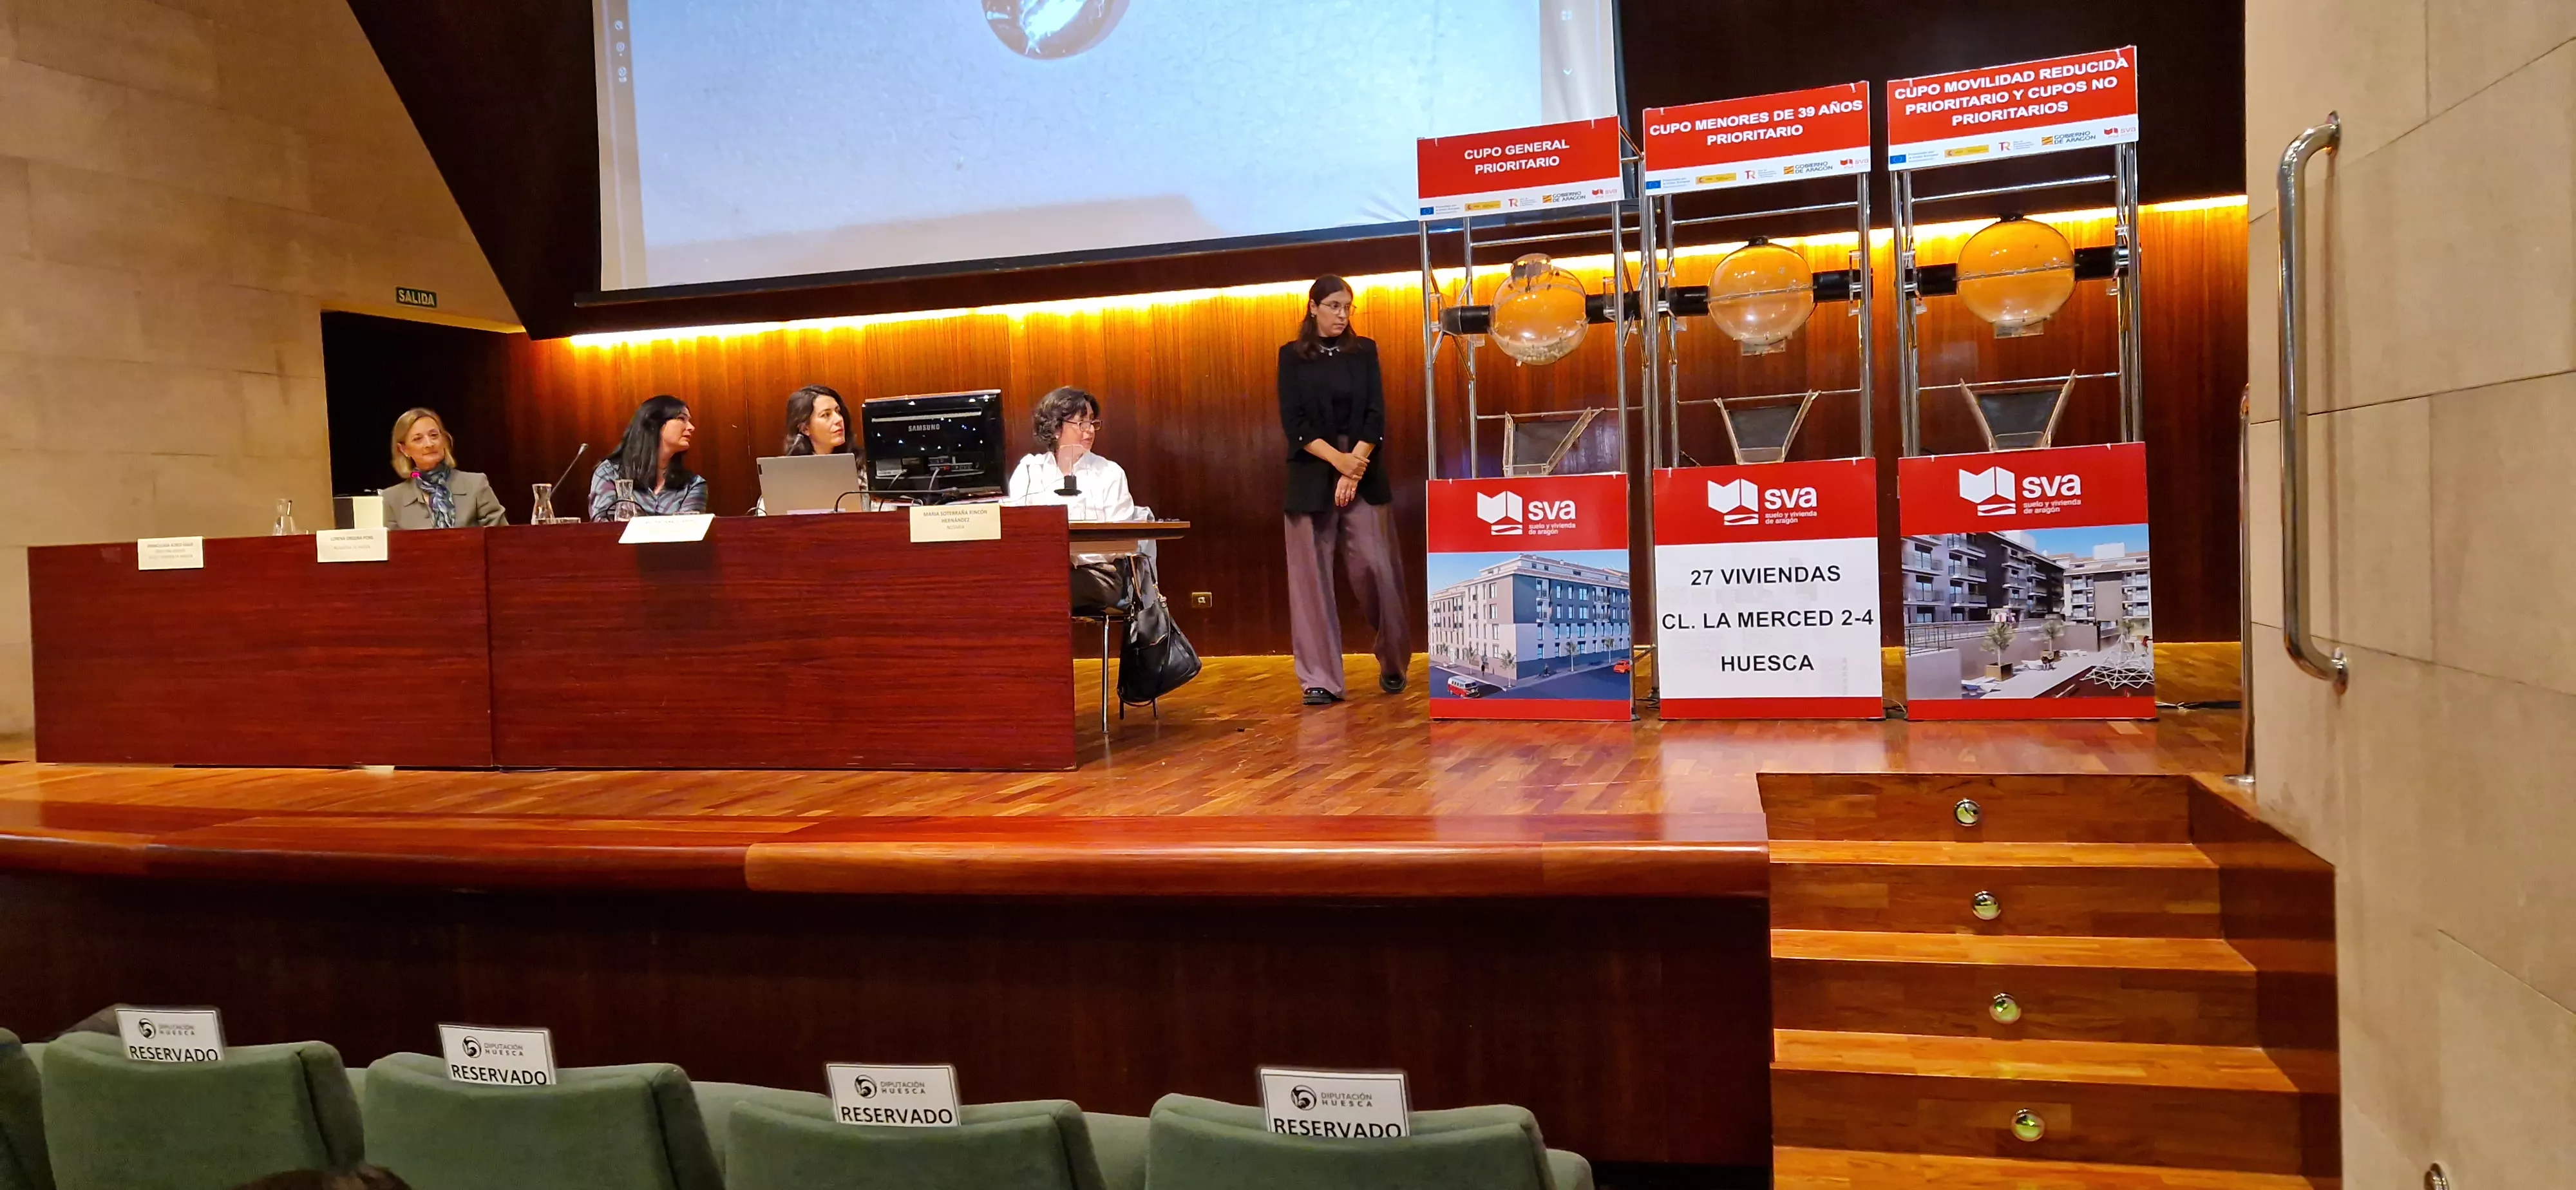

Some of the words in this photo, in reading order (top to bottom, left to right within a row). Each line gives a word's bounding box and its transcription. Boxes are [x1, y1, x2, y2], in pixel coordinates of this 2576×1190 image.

[1895, 84, 1940, 100] CUPO
[1944, 70, 2034, 93] MOVILIDAD
[2040, 57, 2128, 80] REDUCIDA
[1905, 91, 2009, 115] PRIORITARIO
[2013, 90, 2025, 101] Y
[2028, 81, 2087, 99] CUPOS
[2092, 76, 2118, 90] NO
[1650, 122, 1691, 136] CUPO
[1695, 113, 1769, 129] MENORES
[1773, 109, 1794, 121] DE
[1798, 106, 1815, 118] 39
[1819, 100, 1863, 116] AÑOS
[1952, 100, 2069, 126] PRIORITARIOS
[1707, 124, 1803, 146] PRIORITARIO
[2054, 131, 2091, 140] GOBIERNO
[1464, 146, 1501, 160] CUPO
[1505, 138, 1570, 155] GENERAL
[1475, 156, 1560, 175] PRIORITARIO
[1795, 161, 1828, 169] GOBIERNO
[398, 289, 435, 306] SALIDA
[908, 424, 940, 432] SAMSUNG
[2022, 474, 2081, 498] sva
[1765, 486, 1818, 509] sva
[1528, 499, 1576, 520] sva
[1775, 517, 1798, 525] aragón
[1690, 570, 1714, 586] 27
[1721, 565, 1841, 585] VIVIENDAS
[1662, 613, 1695, 630] CL.
[1703, 613, 1731, 629] LA
[1738, 610, 1833, 628] MERCED
[1841, 609, 1874, 626] 2-4
[1721, 654, 1815, 672] HUESCA
[129, 1045, 218, 1062] RESERVADO
[484, 1043, 524, 1051] DIPUTACIÓN
[451, 1064, 547, 1085] RESERVADO
[1320, 1091, 1372, 1100] DIPUTACIÓN
[840, 1106, 953, 1124] RESERVADO
[1273, 1118, 1402, 1138] RESERVADO
